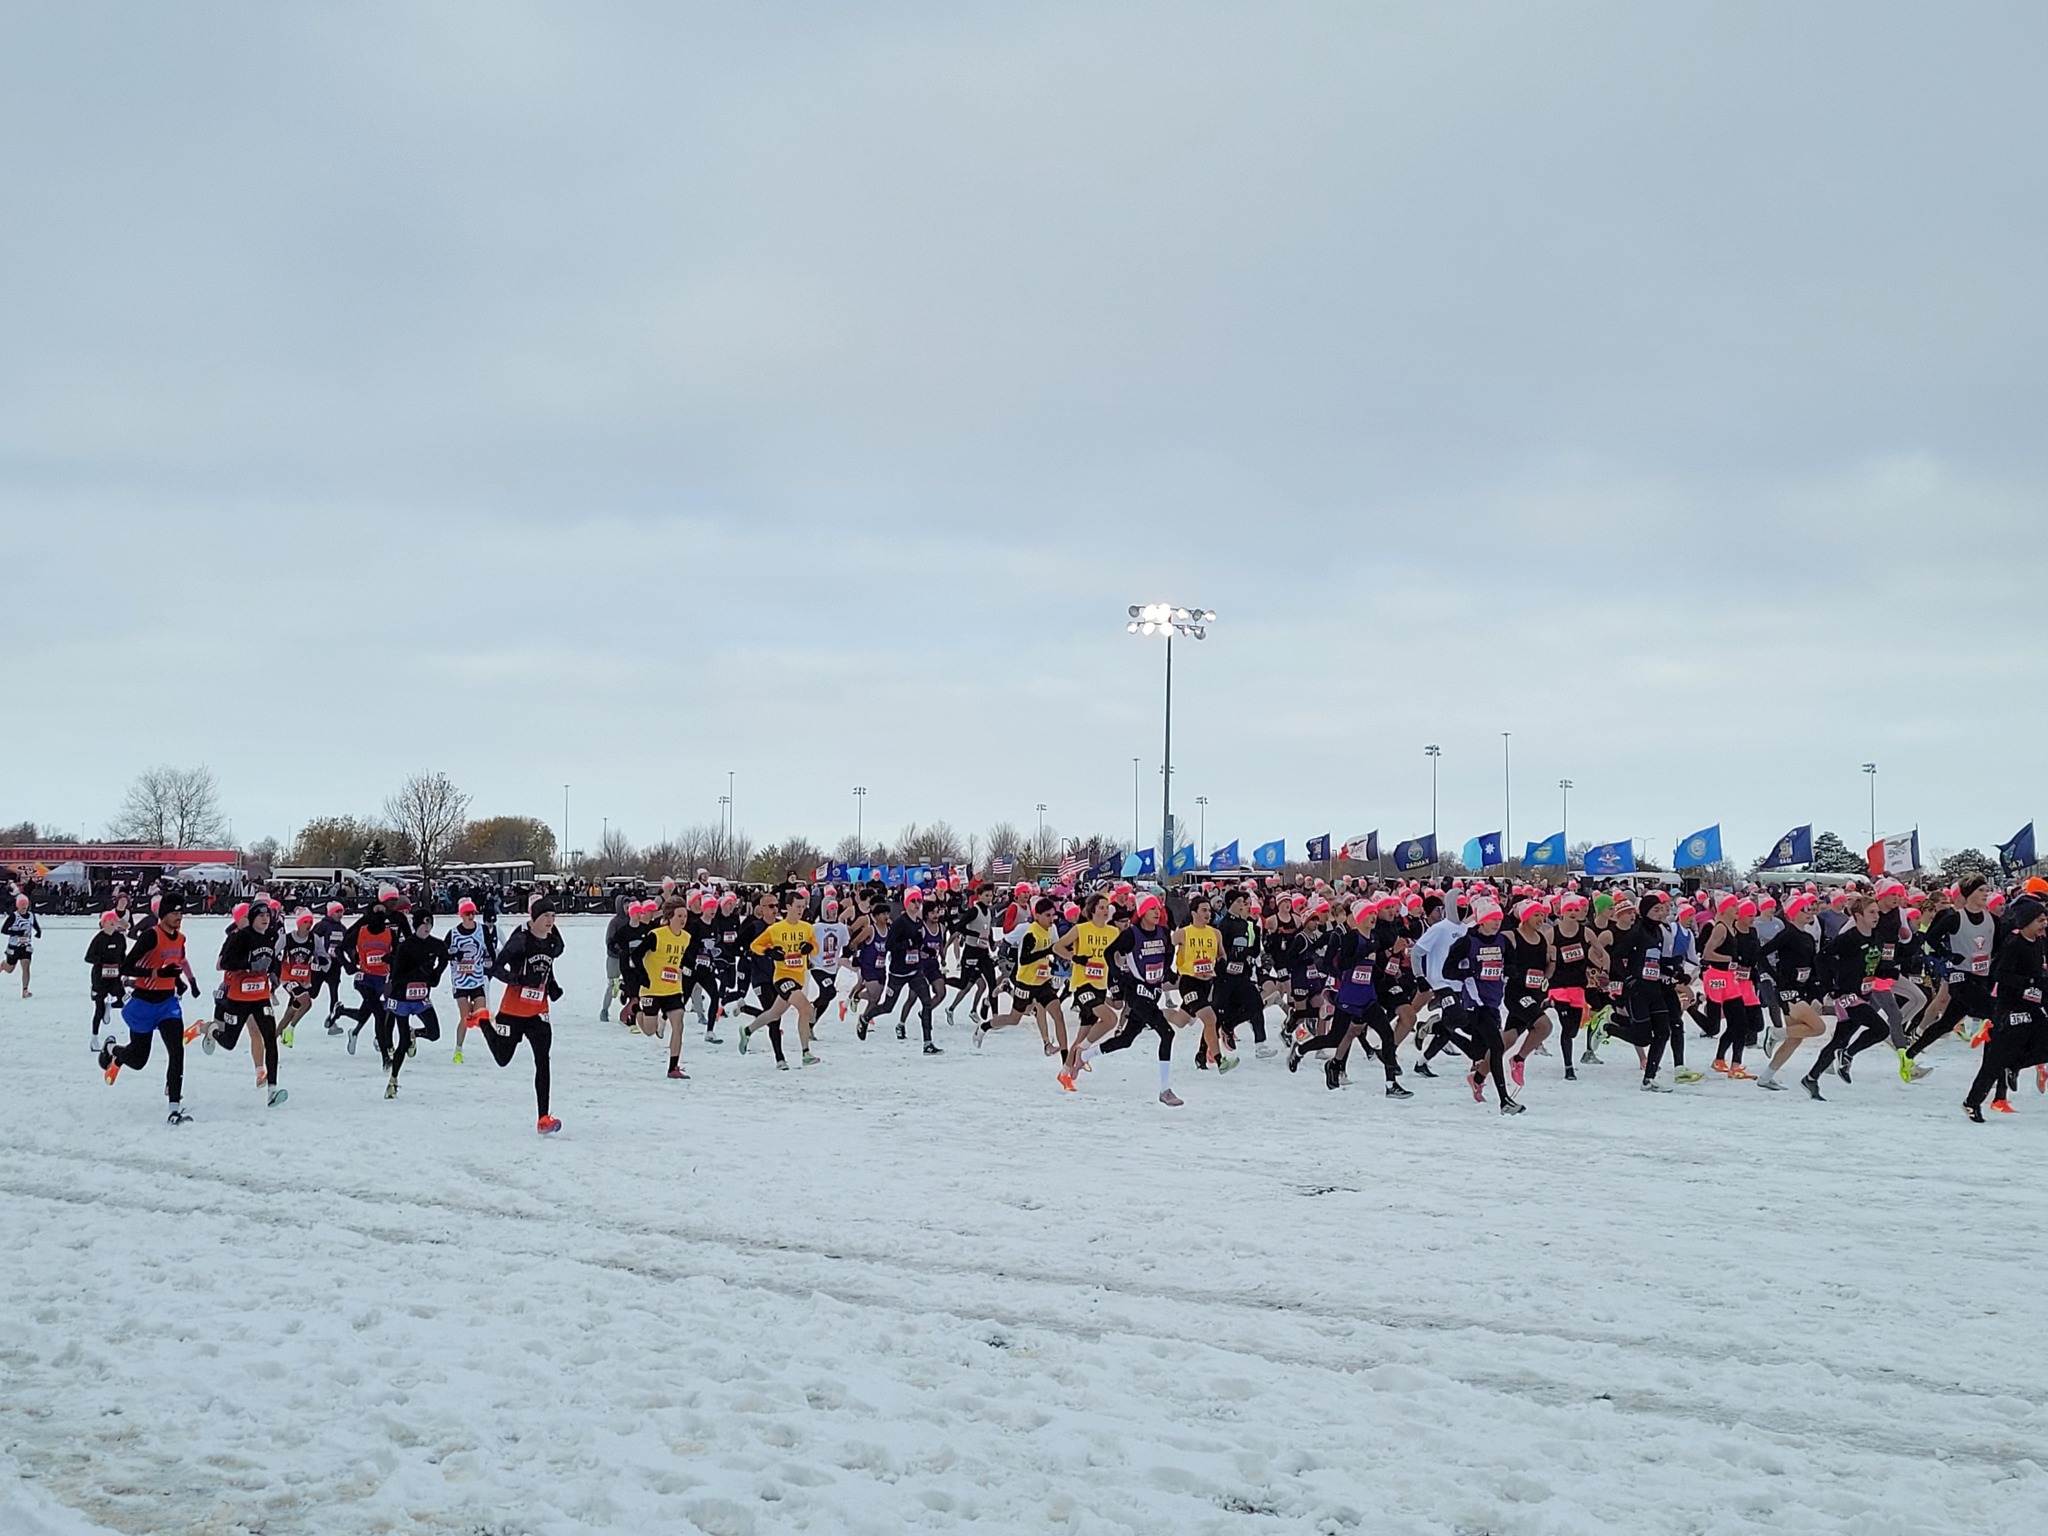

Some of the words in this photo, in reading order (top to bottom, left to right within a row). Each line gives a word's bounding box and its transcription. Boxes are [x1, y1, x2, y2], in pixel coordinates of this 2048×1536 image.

[17, 850, 99, 861] HEARTLAND
[103, 850, 142, 860] START
[782, 932, 804, 941] RHS
[1087, 935, 1108, 946] RHS
[1190, 938, 1213, 948] RHS
[1092, 948, 1103, 958] XC
